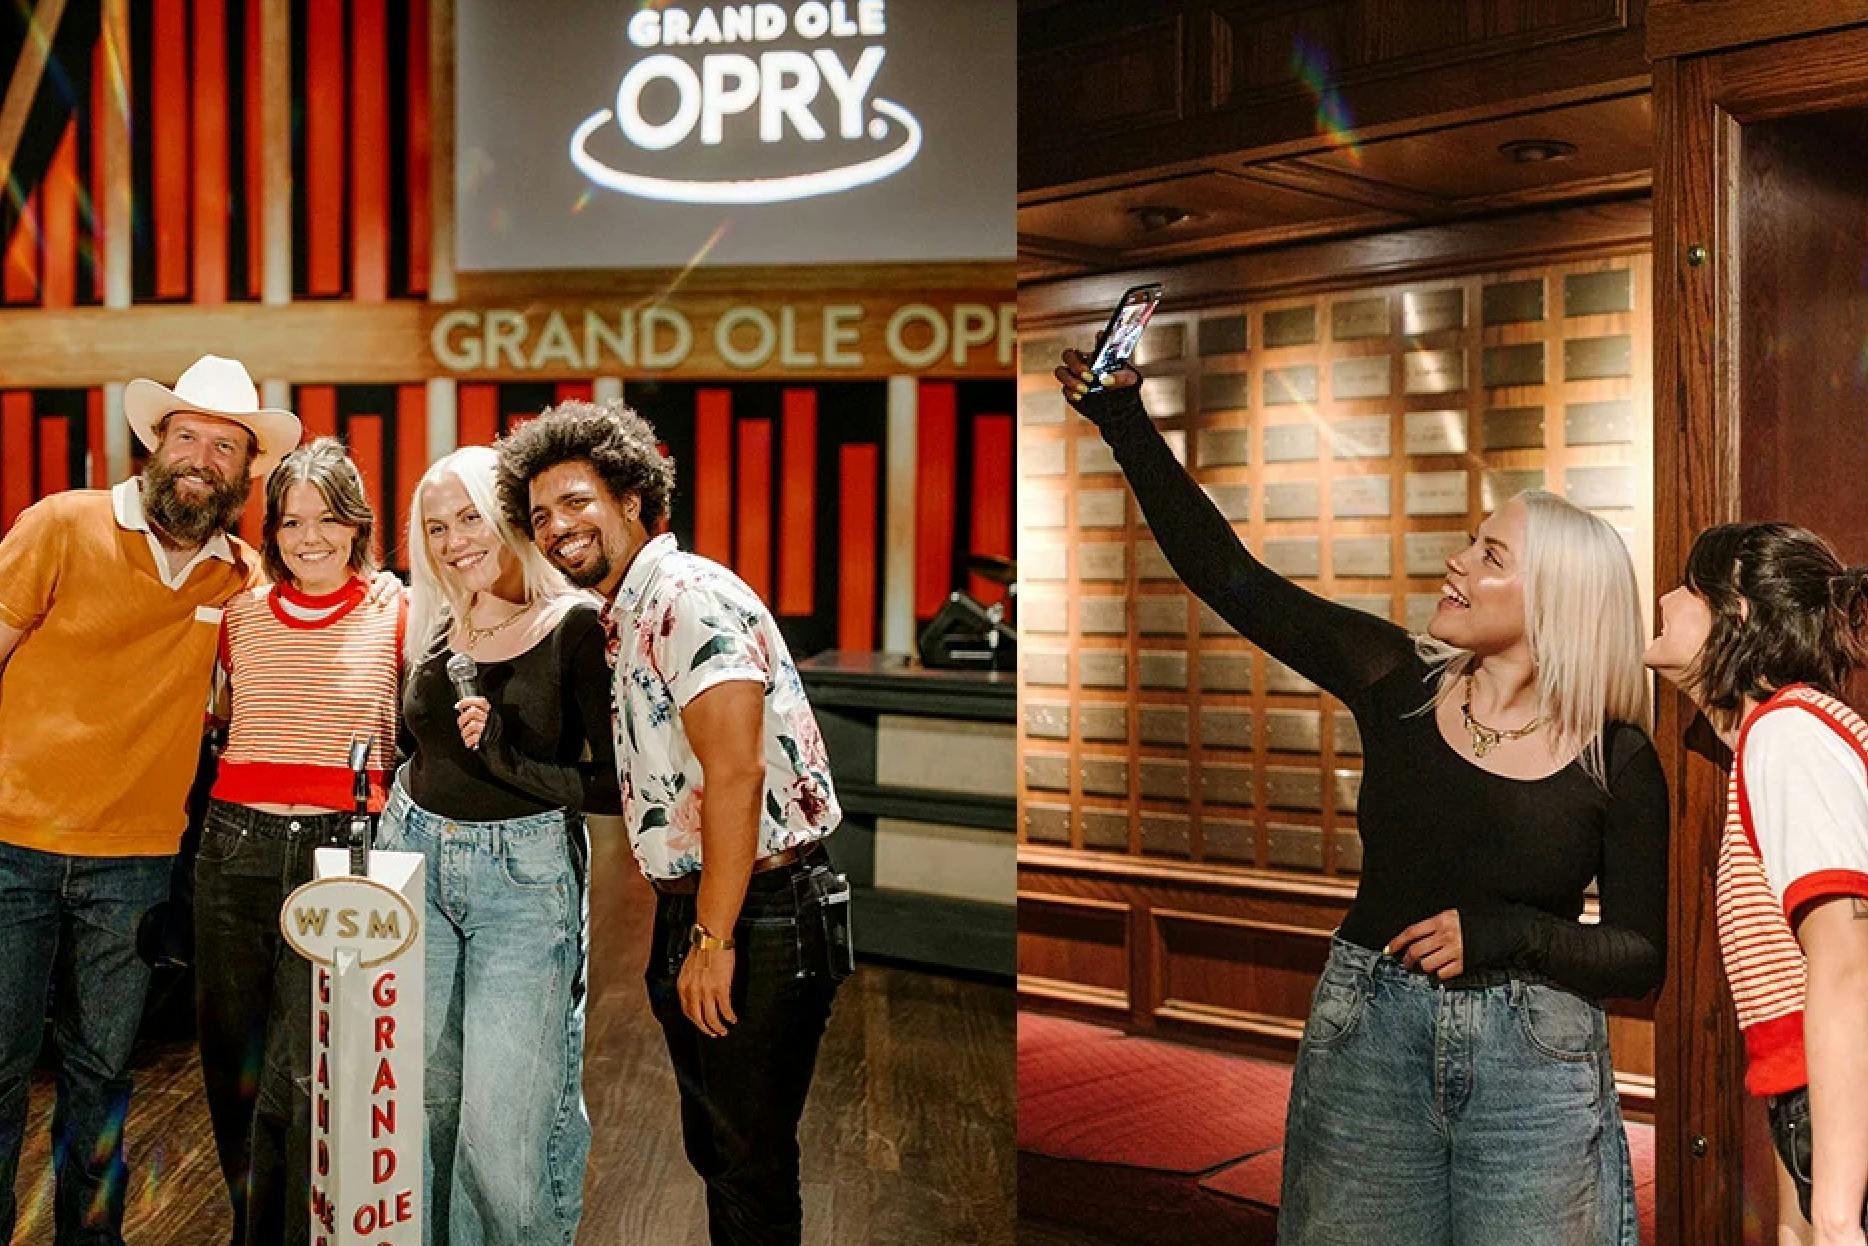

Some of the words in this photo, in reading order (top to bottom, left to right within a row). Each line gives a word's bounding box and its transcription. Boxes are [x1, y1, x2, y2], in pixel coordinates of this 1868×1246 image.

[628, 5, 787, 48] GRAND
[794, 0, 887, 39] OLE
[431, 306, 693, 370] GRAND
[715, 305, 864, 367] OLE
[294, 906, 402, 940] WSM
[372, 972, 397, 1184] GRAND
[353, 1190, 412, 1236] OLE
